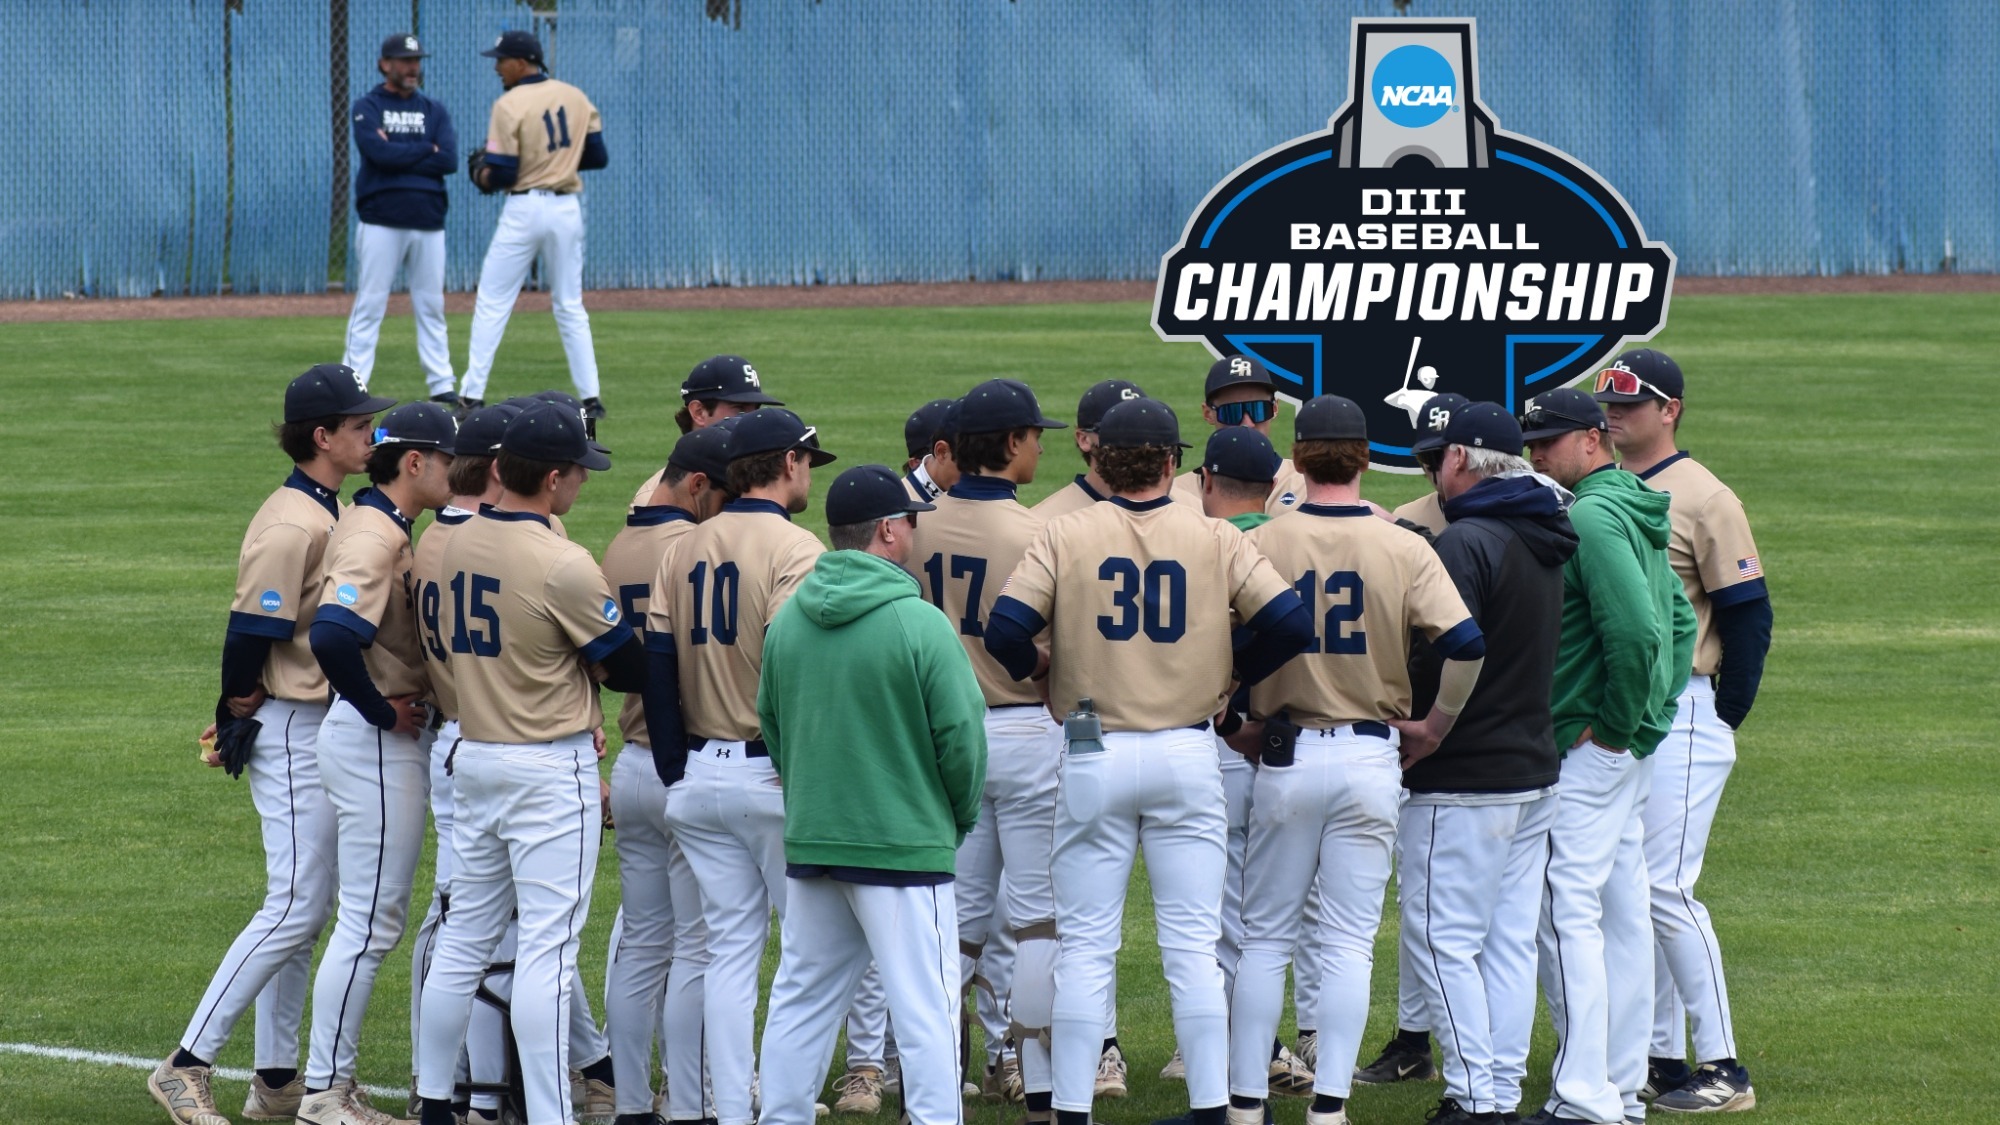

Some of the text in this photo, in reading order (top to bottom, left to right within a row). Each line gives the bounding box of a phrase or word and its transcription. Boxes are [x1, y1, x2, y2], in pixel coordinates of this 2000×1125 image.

[543, 105, 571, 153] 11
[1230, 357, 1252, 377] SR
[1428, 406, 1450, 431] SR
[450, 570, 502, 658] 15
[688, 561, 740, 646] 10
[924, 552, 988, 638] 17
[1097, 556, 1187, 644] 30
[1294, 569, 1367, 655] 12
